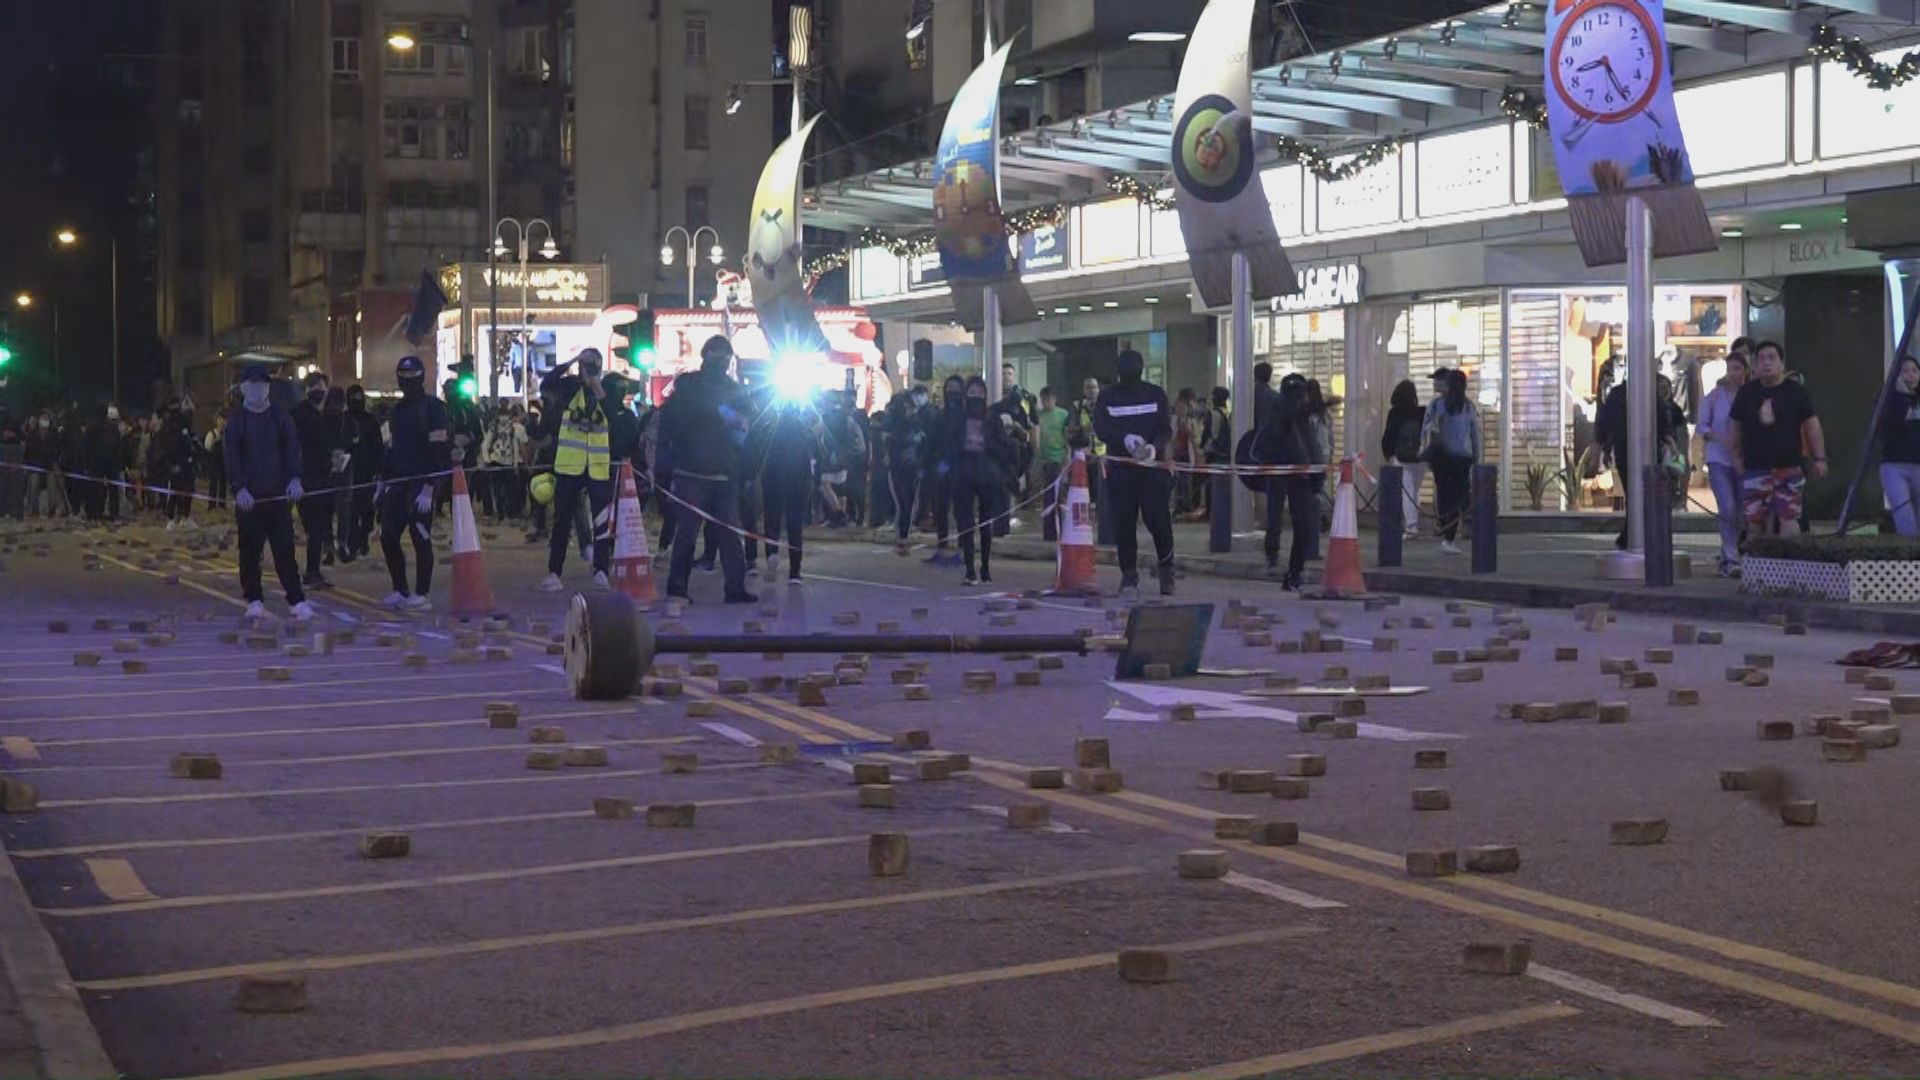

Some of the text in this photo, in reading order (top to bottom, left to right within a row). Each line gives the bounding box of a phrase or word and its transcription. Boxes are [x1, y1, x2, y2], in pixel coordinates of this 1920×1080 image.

[1598, 12, 1609, 25] 12
[1583, 19, 1593, 32] 11
[1630, 27, 1639, 40] 2
[1571, 34, 1582, 47] 10
[1636, 47, 1645, 61] 3
[1565, 56, 1574, 68] 9
[1633, 67, 1642, 80] 4
[1571, 76, 1580, 88] 8
[1584, 88, 1594, 101] 7
[1604, 91, 1613, 103] 6
[1789, 239, 1828, 263] BLOCK
